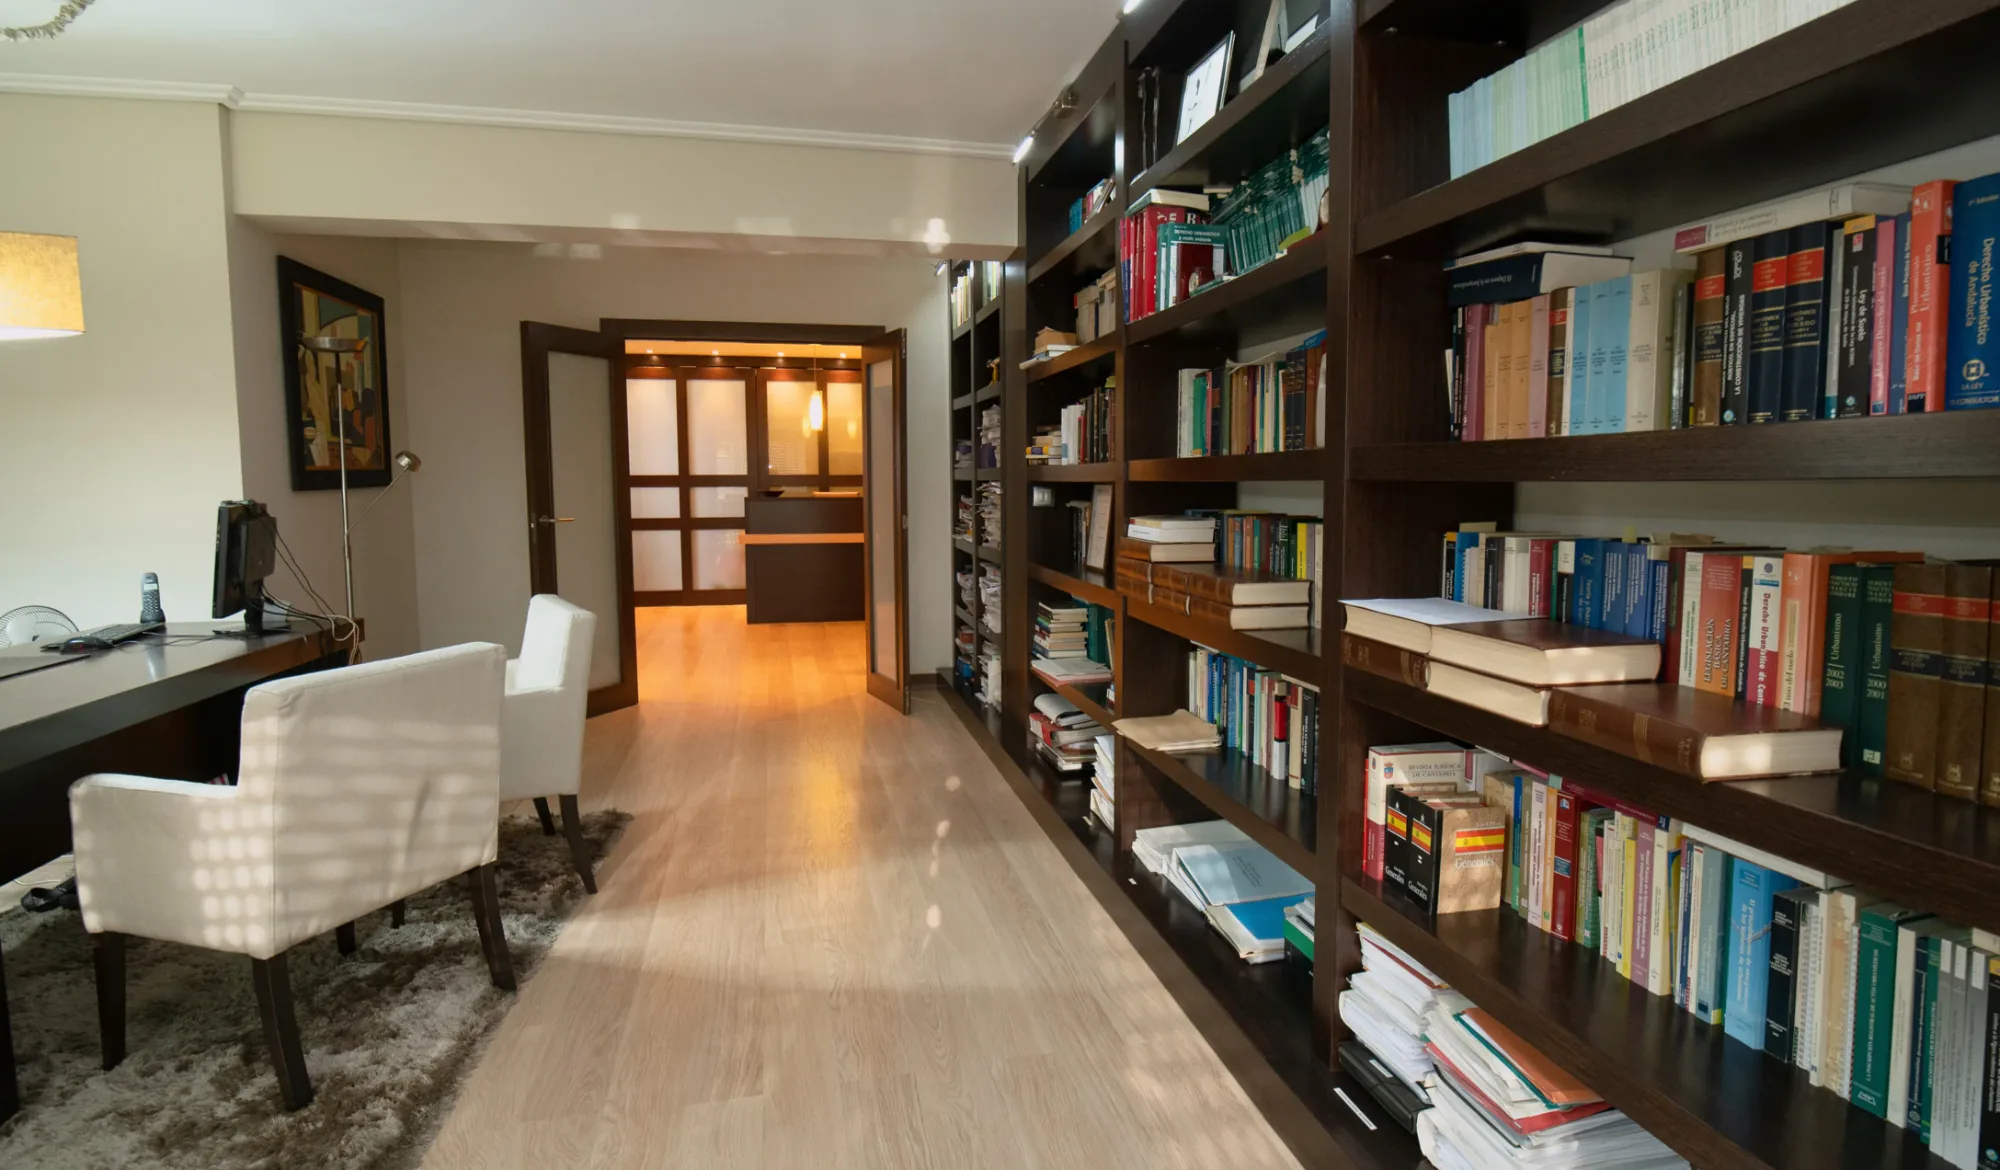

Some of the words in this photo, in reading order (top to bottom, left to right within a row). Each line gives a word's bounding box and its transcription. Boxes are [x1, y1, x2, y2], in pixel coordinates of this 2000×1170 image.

[1968, 260, 1980, 274] de
[1981, 237, 1996, 282] Derecho
[1919, 244, 1933, 311] Urbanístico
[1858, 289, 1868, 304] Ley
[1965, 276, 1980, 328] Andalucía
[1858, 306, 1868, 316] de
[1977, 284, 1993, 346] Urbanístico
[1738, 327, 1744, 336] DE
[1858, 318, 1868, 342] Suelo
[1735, 337, 1743, 386] CONSTRUCCIÓN
[1734, 386, 1740, 394] LA
[1760, 593, 1771, 624] Derecho
[1722, 618, 1732, 672] CANTABRIA
[1758, 626, 1770, 668] Urbanístico
[1832, 613, 1842, 660] Urbanismo
[1872, 623, 1882, 670] Urbanismo
[1703, 618, 1714, 682] LEGISLACIÓN
[1712, 634, 1723, 669] BÁSICA
[1786, 650, 1794, 671] suelo
[1720, 674, 1730, 688] DE
[1758, 672, 1766, 682] de
[1784, 672, 1792, 686] del
[1826, 668, 1844, 678] 2002
[1826, 679, 1844, 689] 2003
[1866, 690, 1884, 699] 2001
[1867, 679, 1887, 690] 2000
[1455, 856, 1494, 869] Generales
[1386, 866, 1404, 885] Generales
[1408, 880, 1428, 901] Generales
